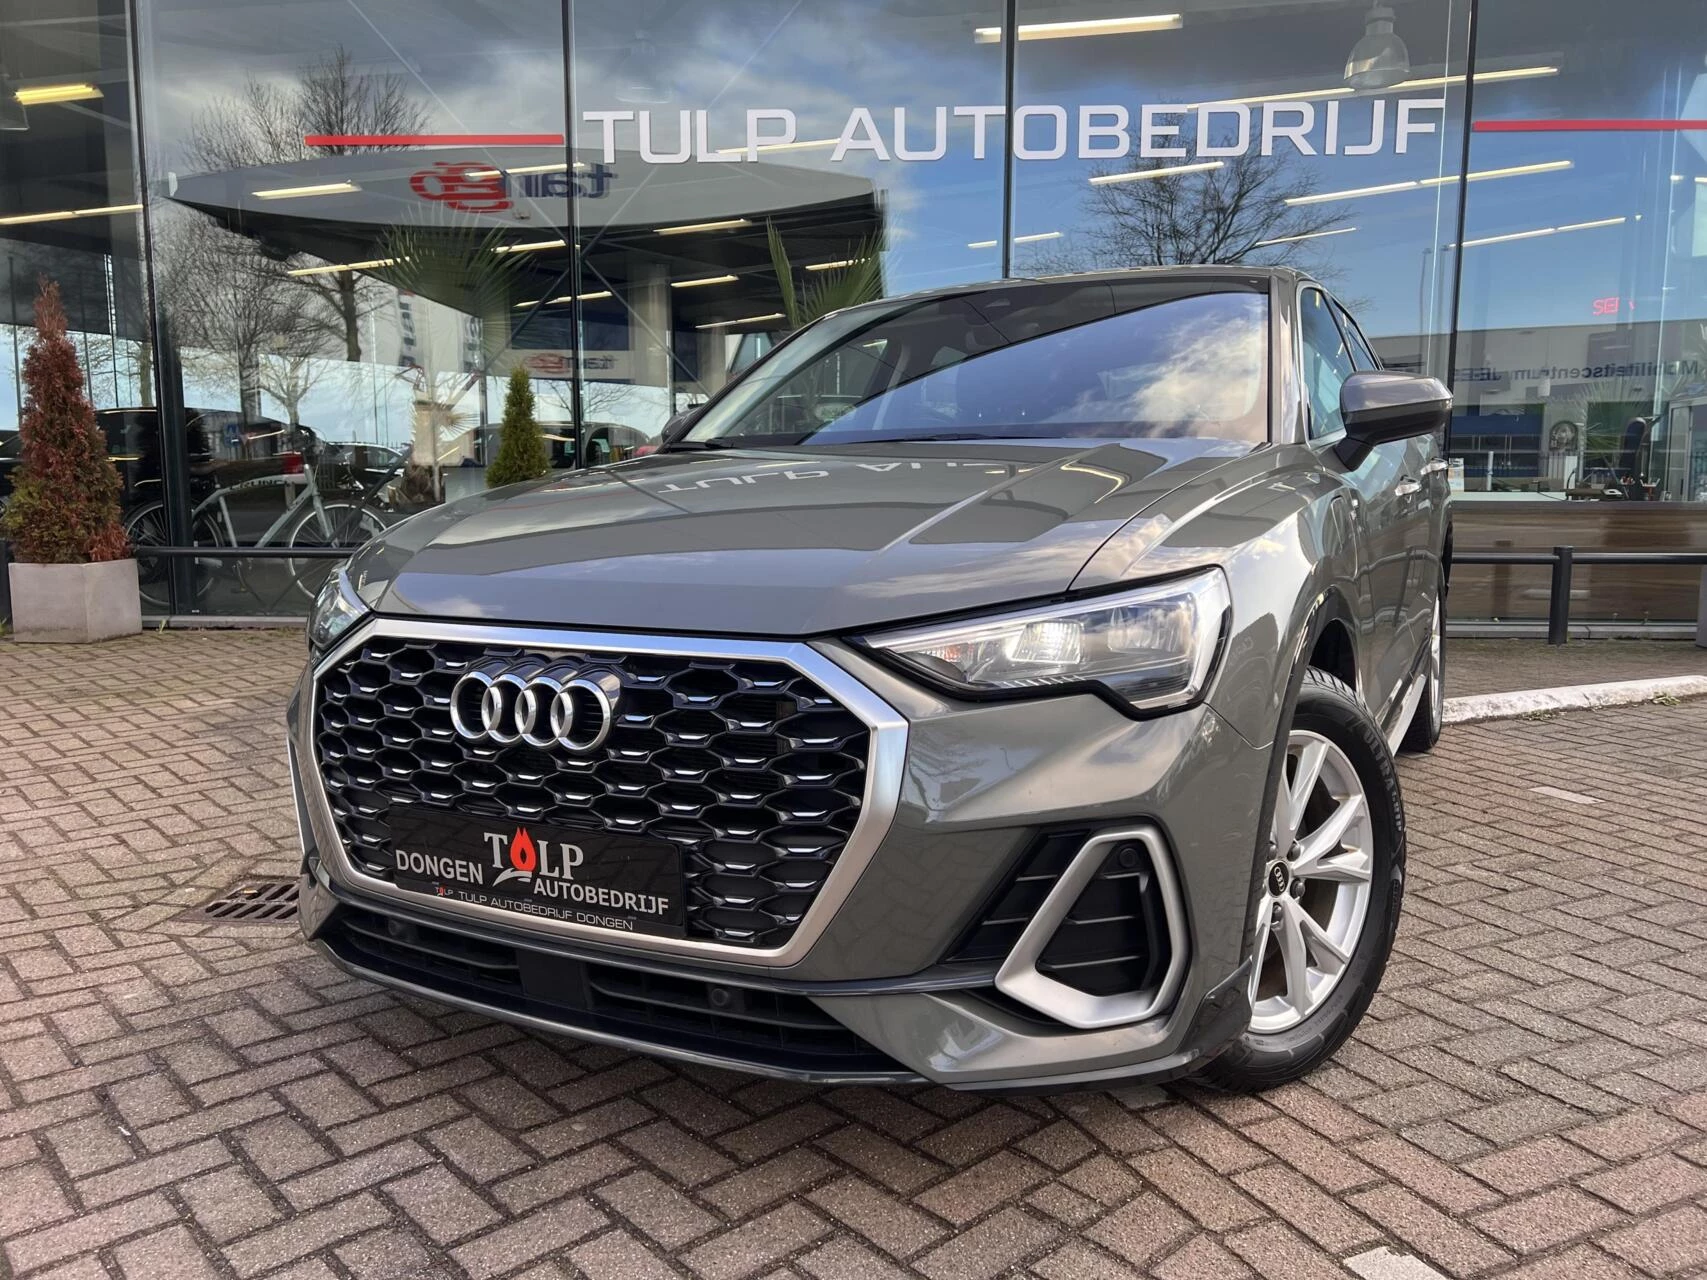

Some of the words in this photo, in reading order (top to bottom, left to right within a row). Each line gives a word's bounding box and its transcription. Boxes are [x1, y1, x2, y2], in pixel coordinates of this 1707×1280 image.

[582, 108, 797, 164] TULP
[830, 98, 1446, 162] AUTOBEDRIJF
[395, 849, 484, 885] DONGEN
[458, 890, 488, 904] TULP
[490, 897, 573, 919] AUTOBEDRIJF
[576, 912, 634, 931] DONGEN
[533, 880, 670, 916] AUTOBEDRIJF
